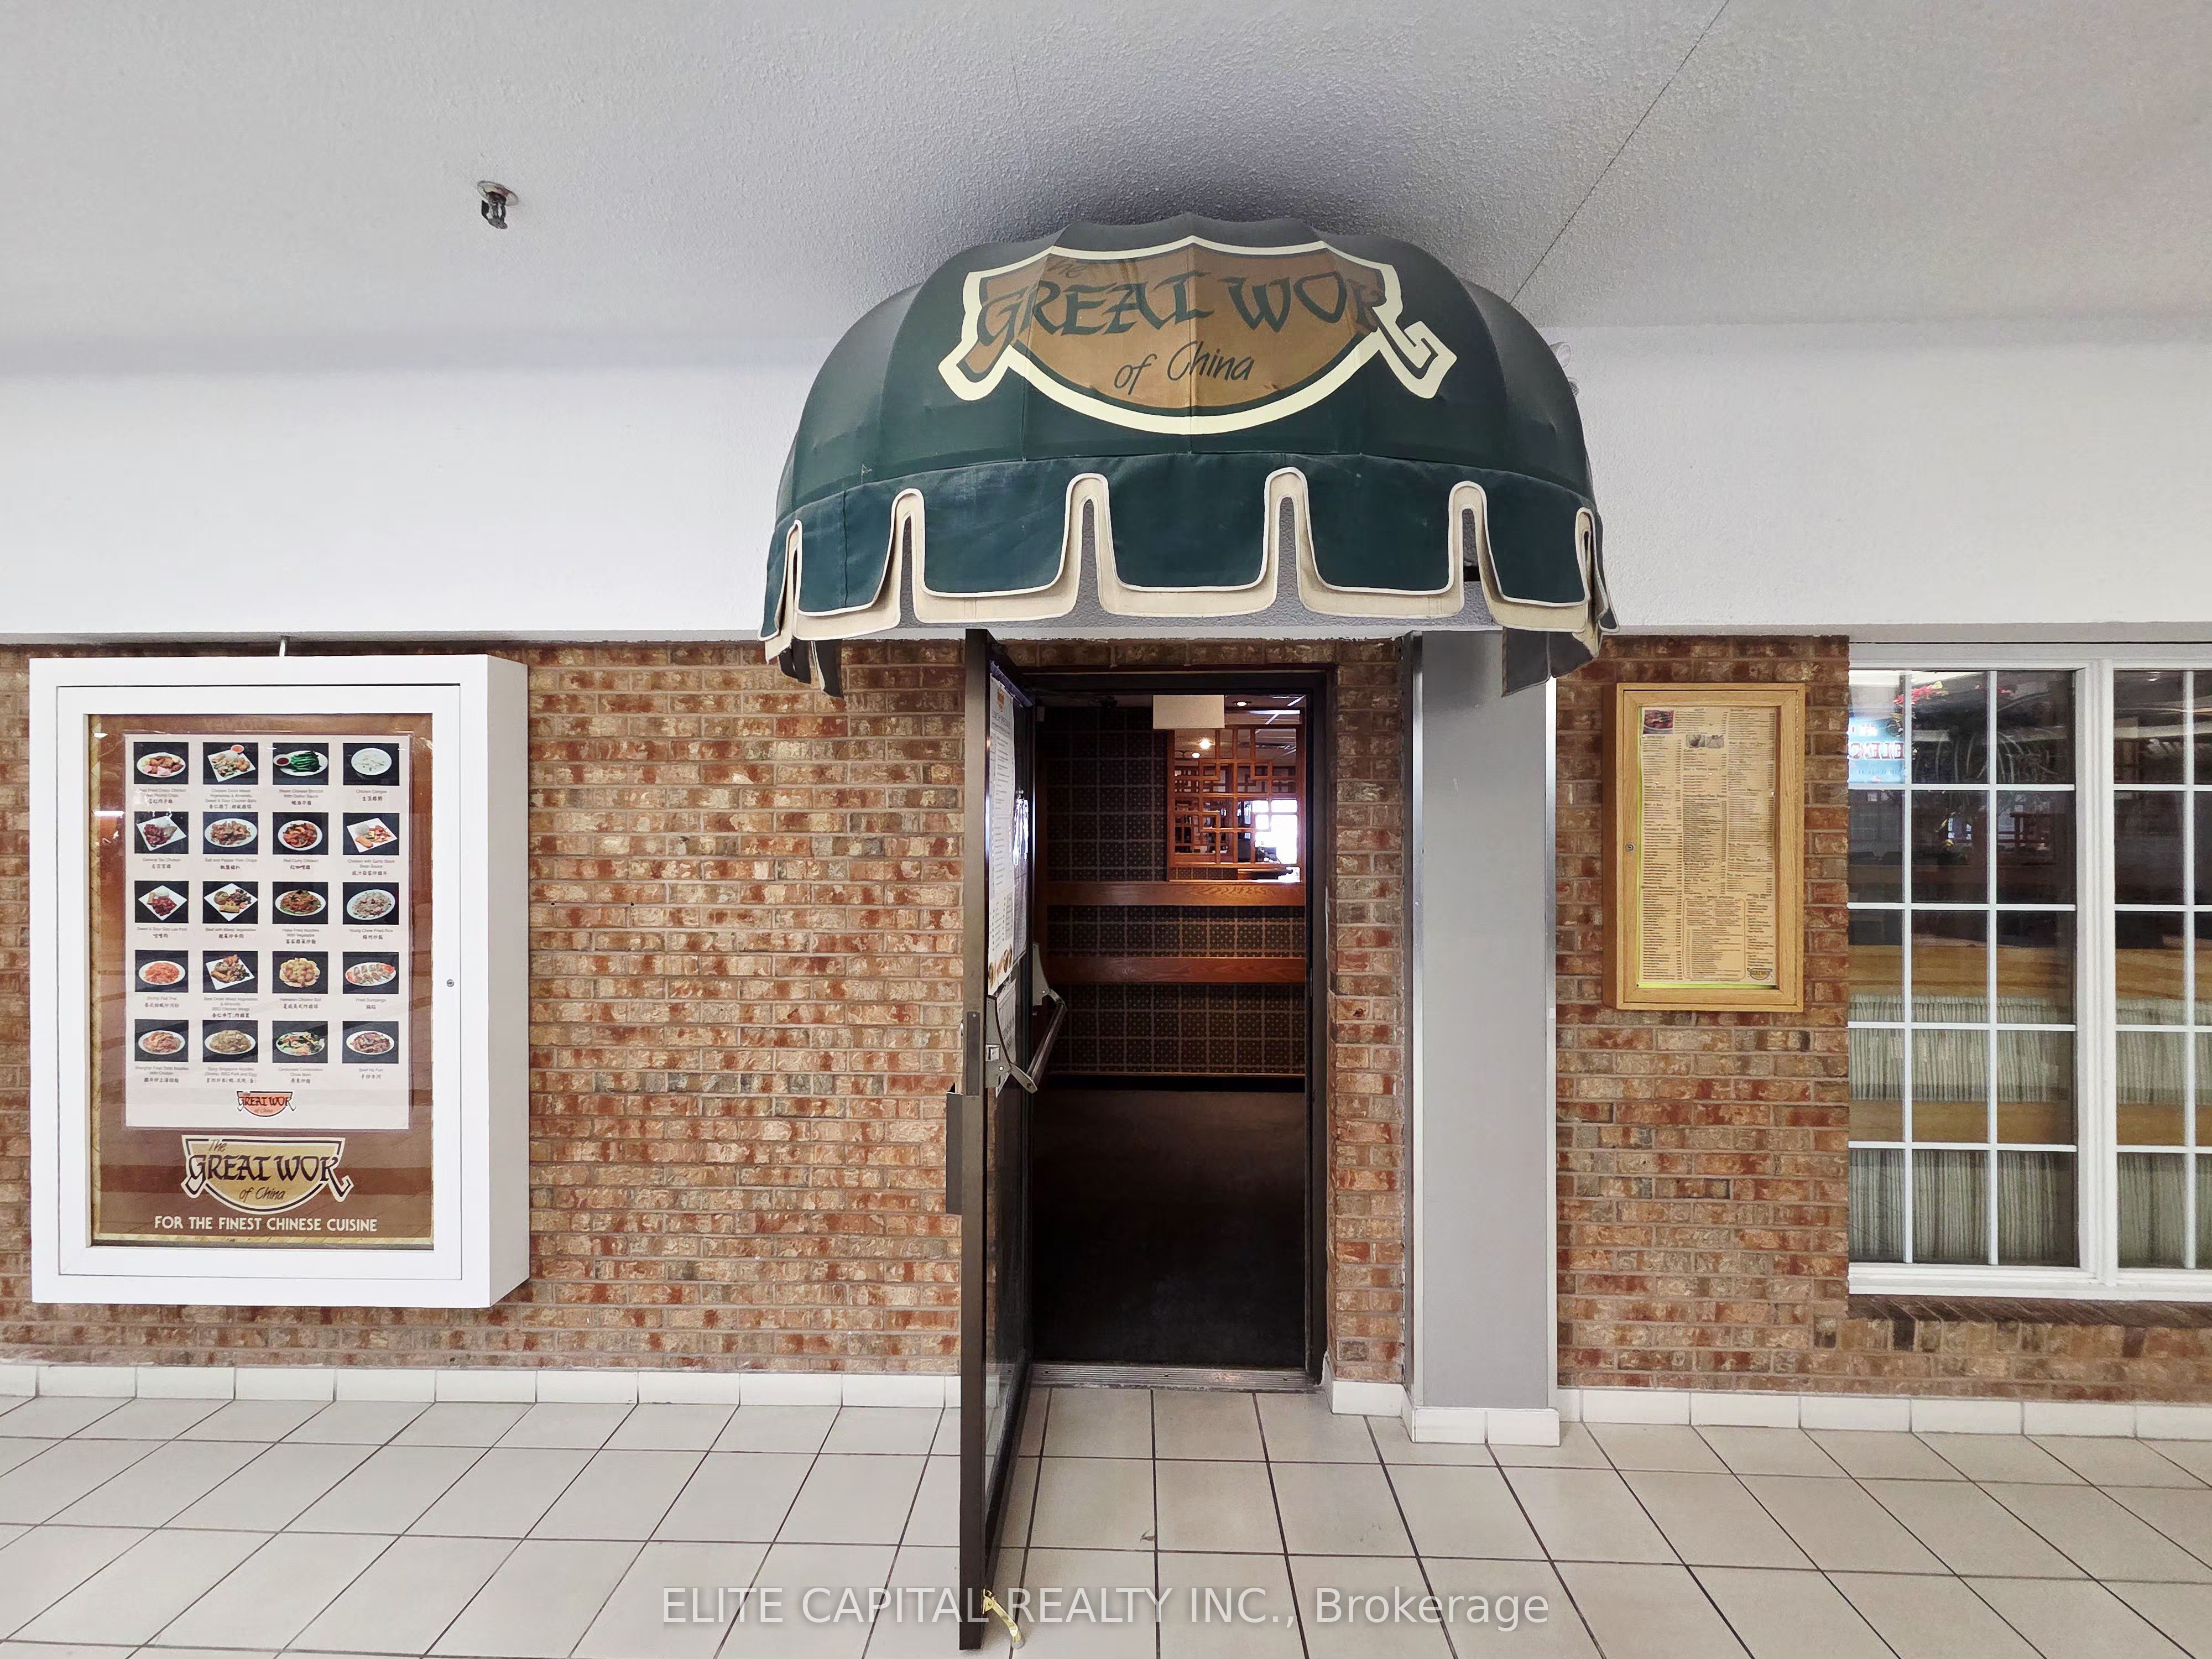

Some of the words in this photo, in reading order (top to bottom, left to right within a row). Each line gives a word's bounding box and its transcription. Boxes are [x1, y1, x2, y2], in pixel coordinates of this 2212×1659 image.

[968, 271, 1215, 359] GREAT
[1114, 353, 1157, 395] of
[1167, 340, 1255, 382] China
[238, 1097, 267, 1107] GREAT
[208, 1139, 227, 1152] The
[187, 1155, 271, 1187] GREAT
[274, 1156, 346, 1189] WOK
[239, 1187, 254, 1203] of
[255, 1187, 285, 1200] China
[154, 1216, 183, 1229] FOR
[189, 1217, 213, 1230] THE
[218, 1217, 261, 1230] FINEST
[266, 1218, 321, 1232] CHINESE
[326, 1219, 377, 1232] CUISINE
